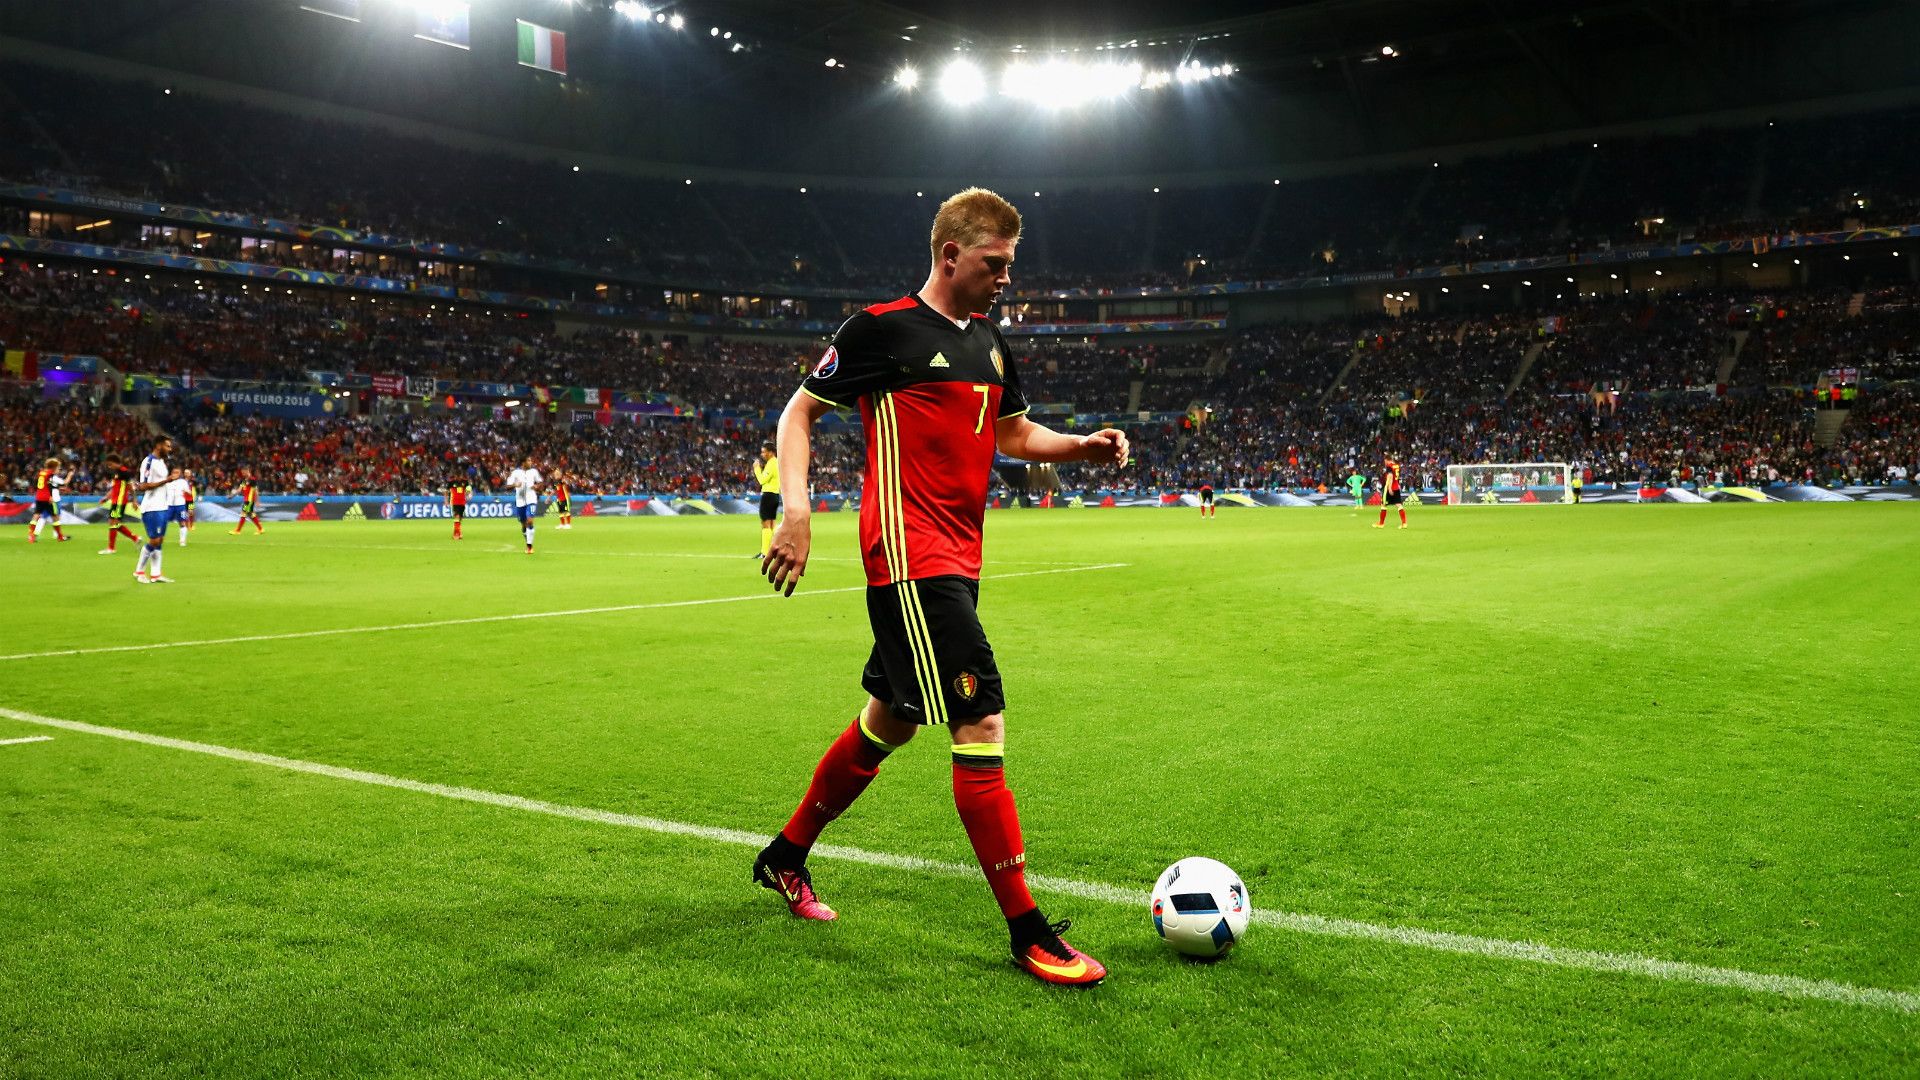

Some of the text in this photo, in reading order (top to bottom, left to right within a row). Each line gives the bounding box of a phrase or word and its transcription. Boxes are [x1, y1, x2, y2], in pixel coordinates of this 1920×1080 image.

[1627, 250, 1650, 259] LYON
[222, 392, 312, 407] UEFA EURO 2016
[972, 385, 990, 434] 7
[403, 503, 440, 518] UEFA
[480, 503, 513, 517] 2016
